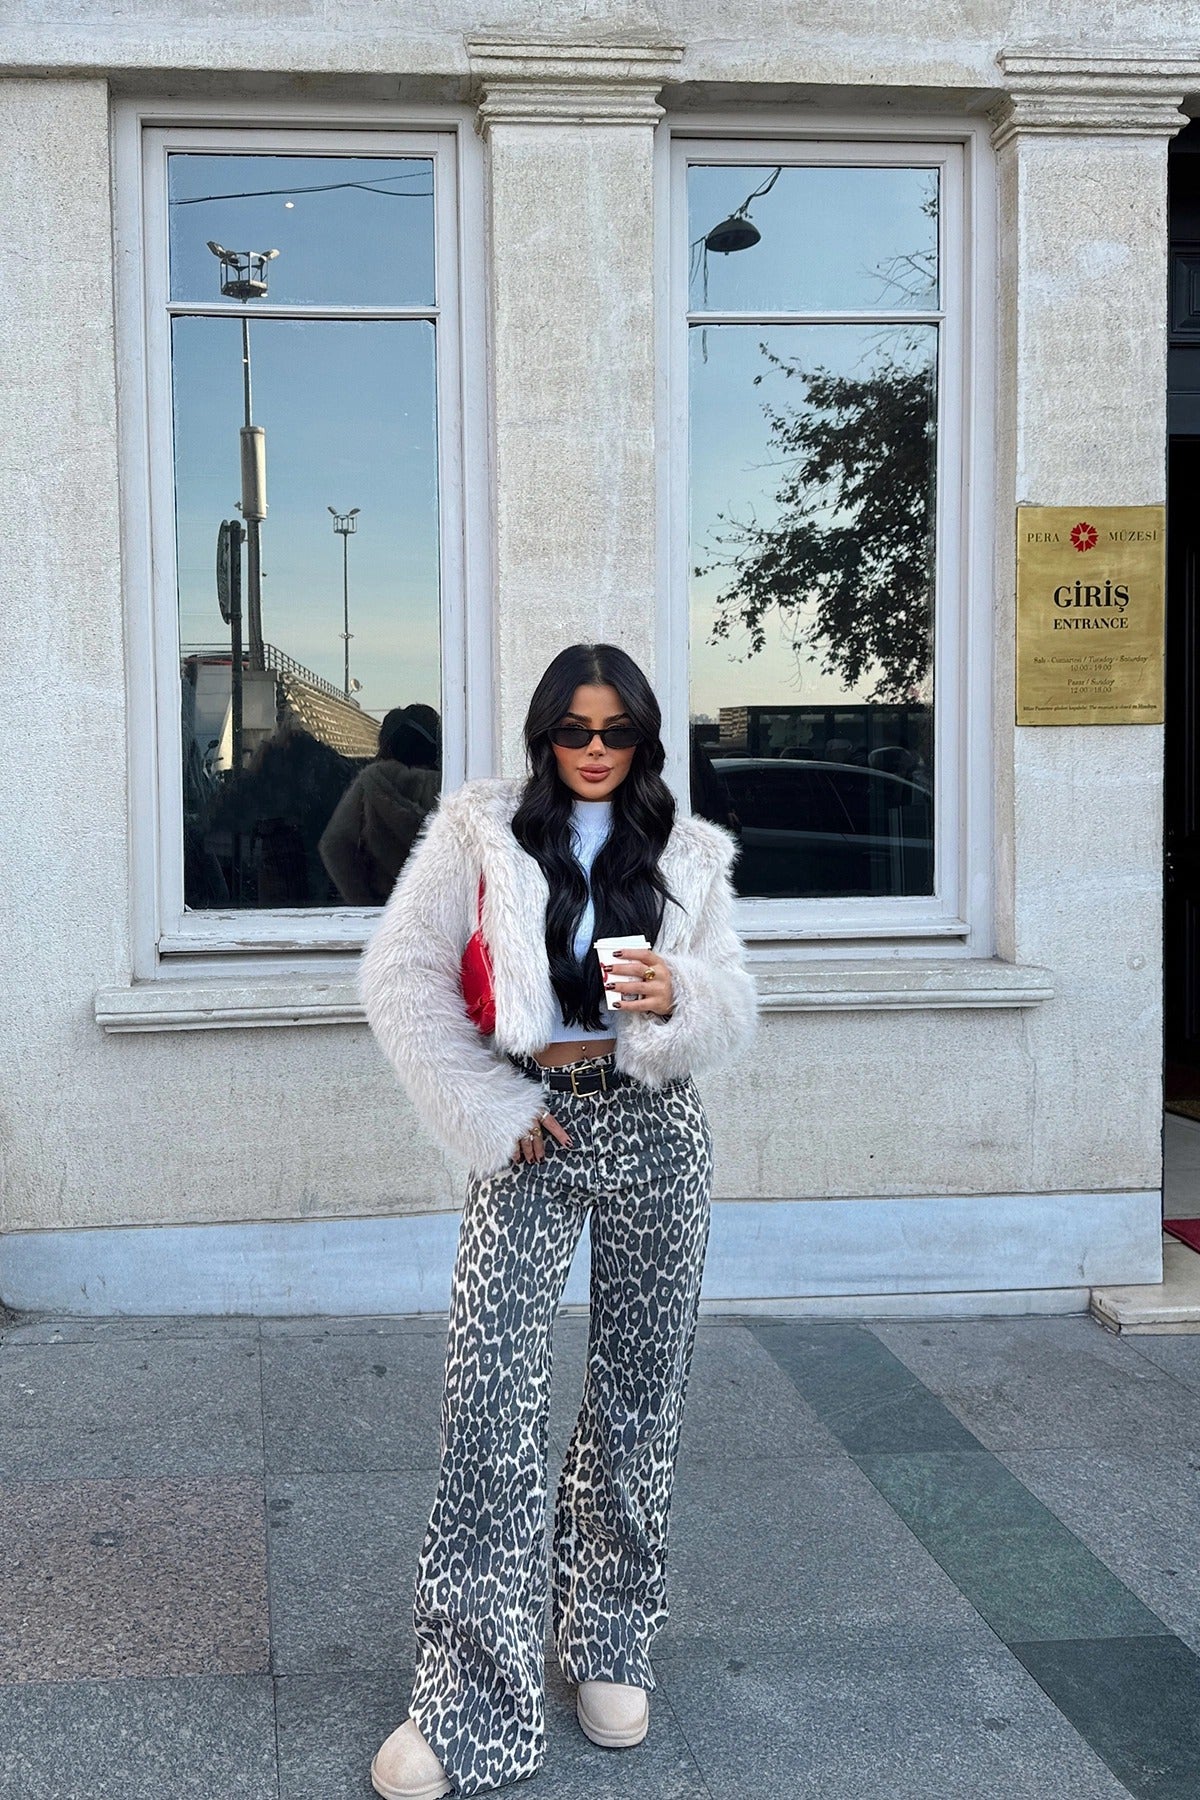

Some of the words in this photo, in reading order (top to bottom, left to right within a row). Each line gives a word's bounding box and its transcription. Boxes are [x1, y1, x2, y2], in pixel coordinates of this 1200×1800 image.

[1027, 532, 1060, 543] PERA
[1053, 580, 1130, 612] GİRİŞ
[1053, 617, 1129, 630] ENTRANCE
